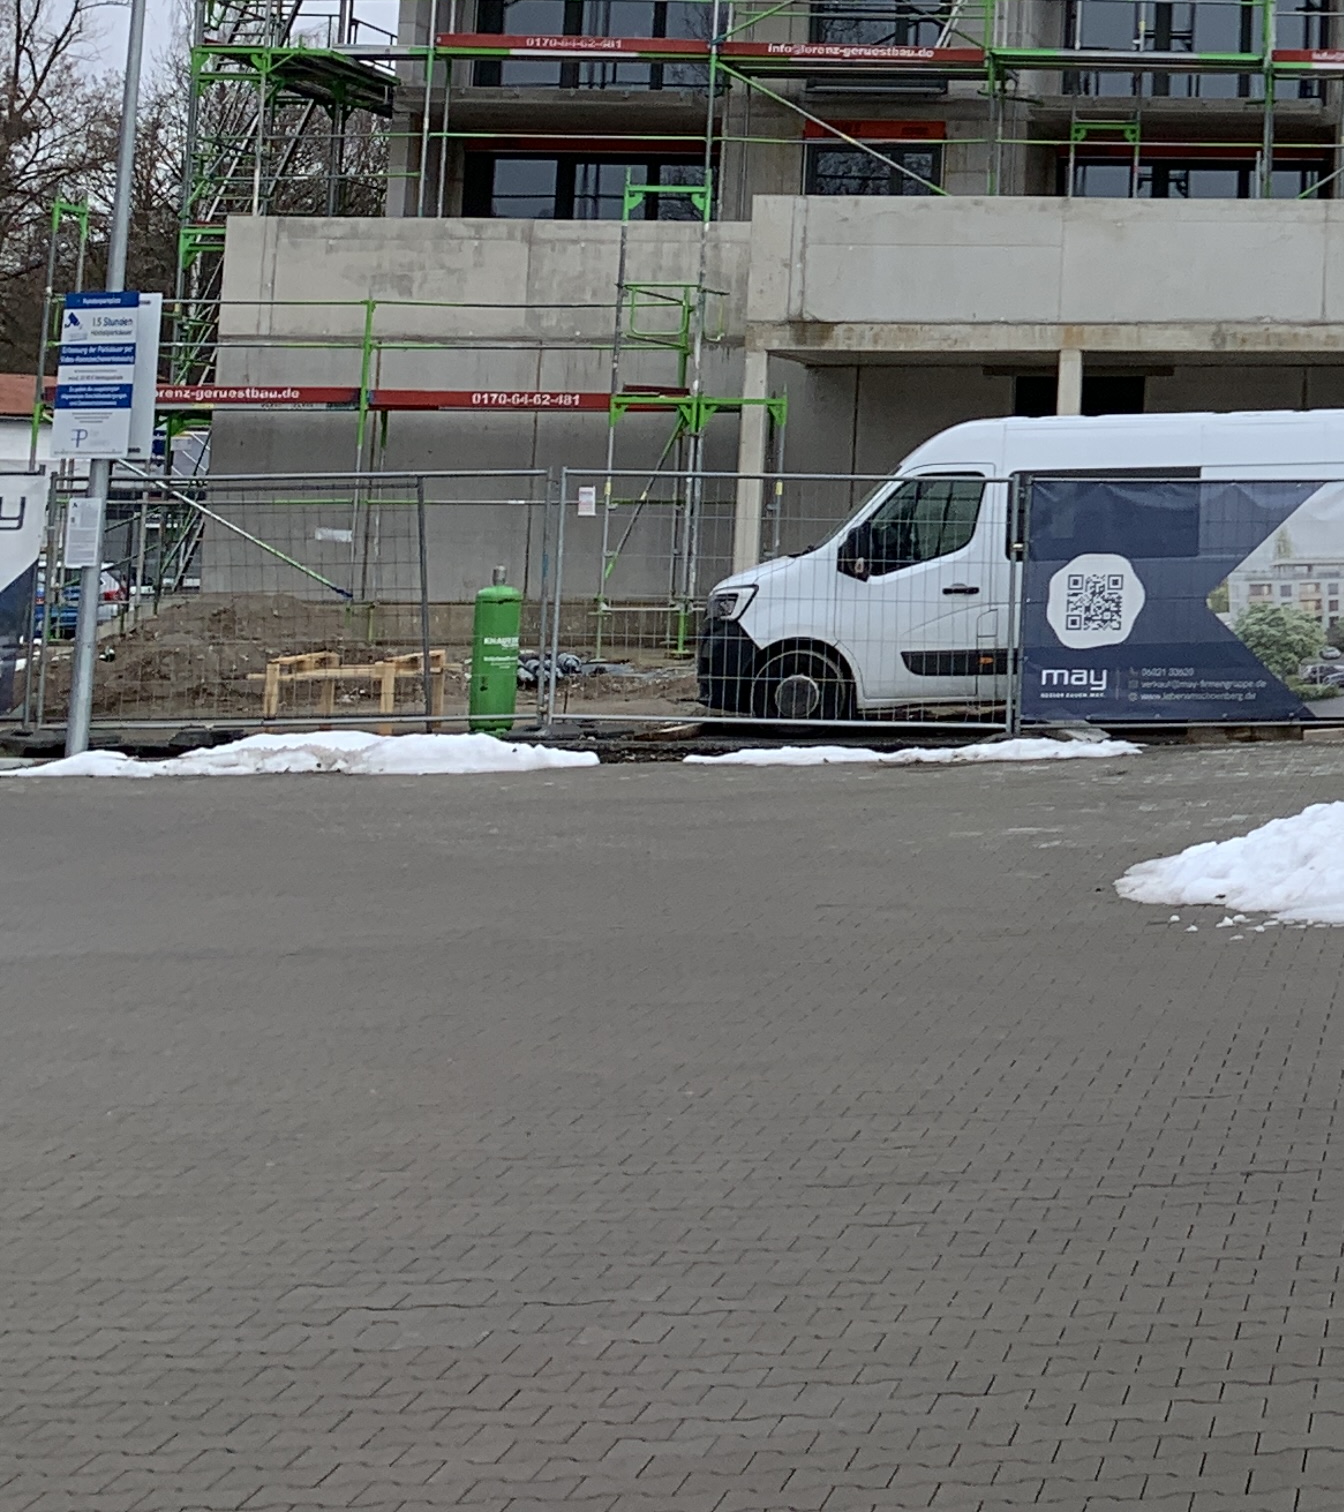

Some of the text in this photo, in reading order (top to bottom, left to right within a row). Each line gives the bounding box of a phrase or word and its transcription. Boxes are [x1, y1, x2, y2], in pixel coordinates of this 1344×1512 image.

[103, 316, 133, 326] Stunden
[472, 393, 580, 406] 0170-64-62-481
[1041, 669, 1107, 691] may
